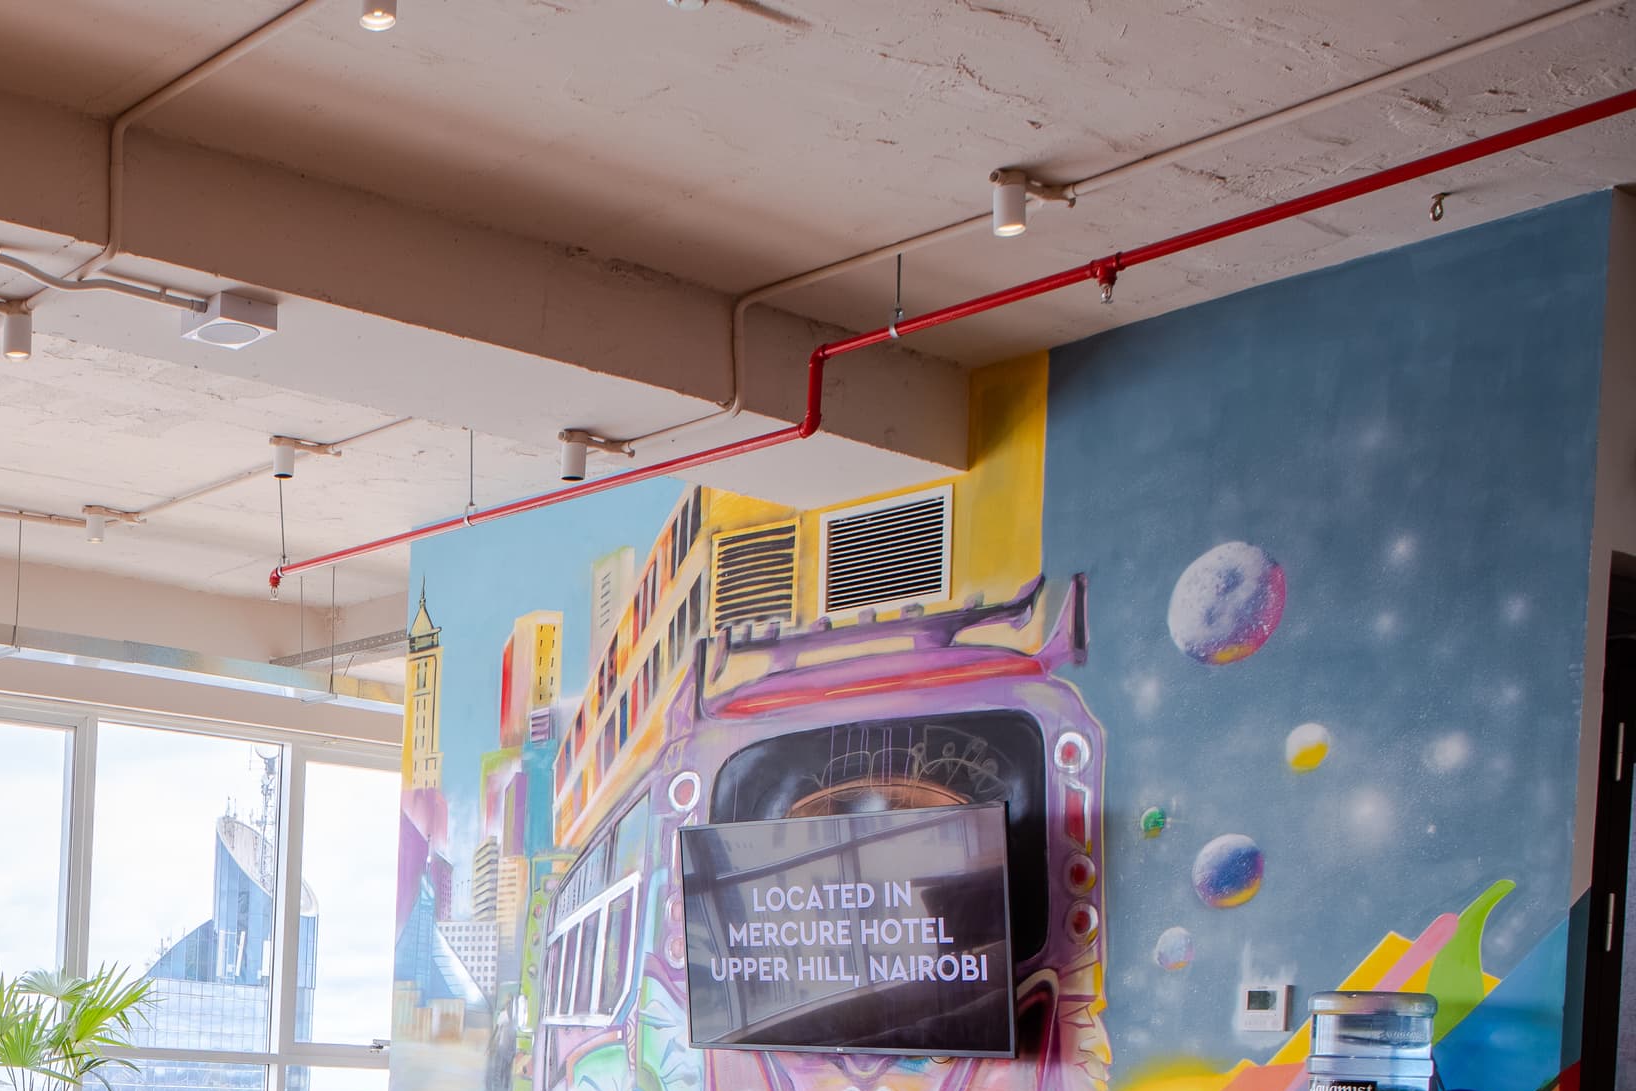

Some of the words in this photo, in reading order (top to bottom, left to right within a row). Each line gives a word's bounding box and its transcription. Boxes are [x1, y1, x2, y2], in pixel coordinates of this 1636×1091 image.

[753, 884, 875, 912] LOCATED
[884, 880, 911, 908] IN
[729, 919, 852, 947] MERCURE
[860, 917, 953, 945] HOTEL
[711, 956, 789, 982] UPPER
[797, 956, 860, 988] HILL,
[869, 953, 988, 982] NAIROBI
